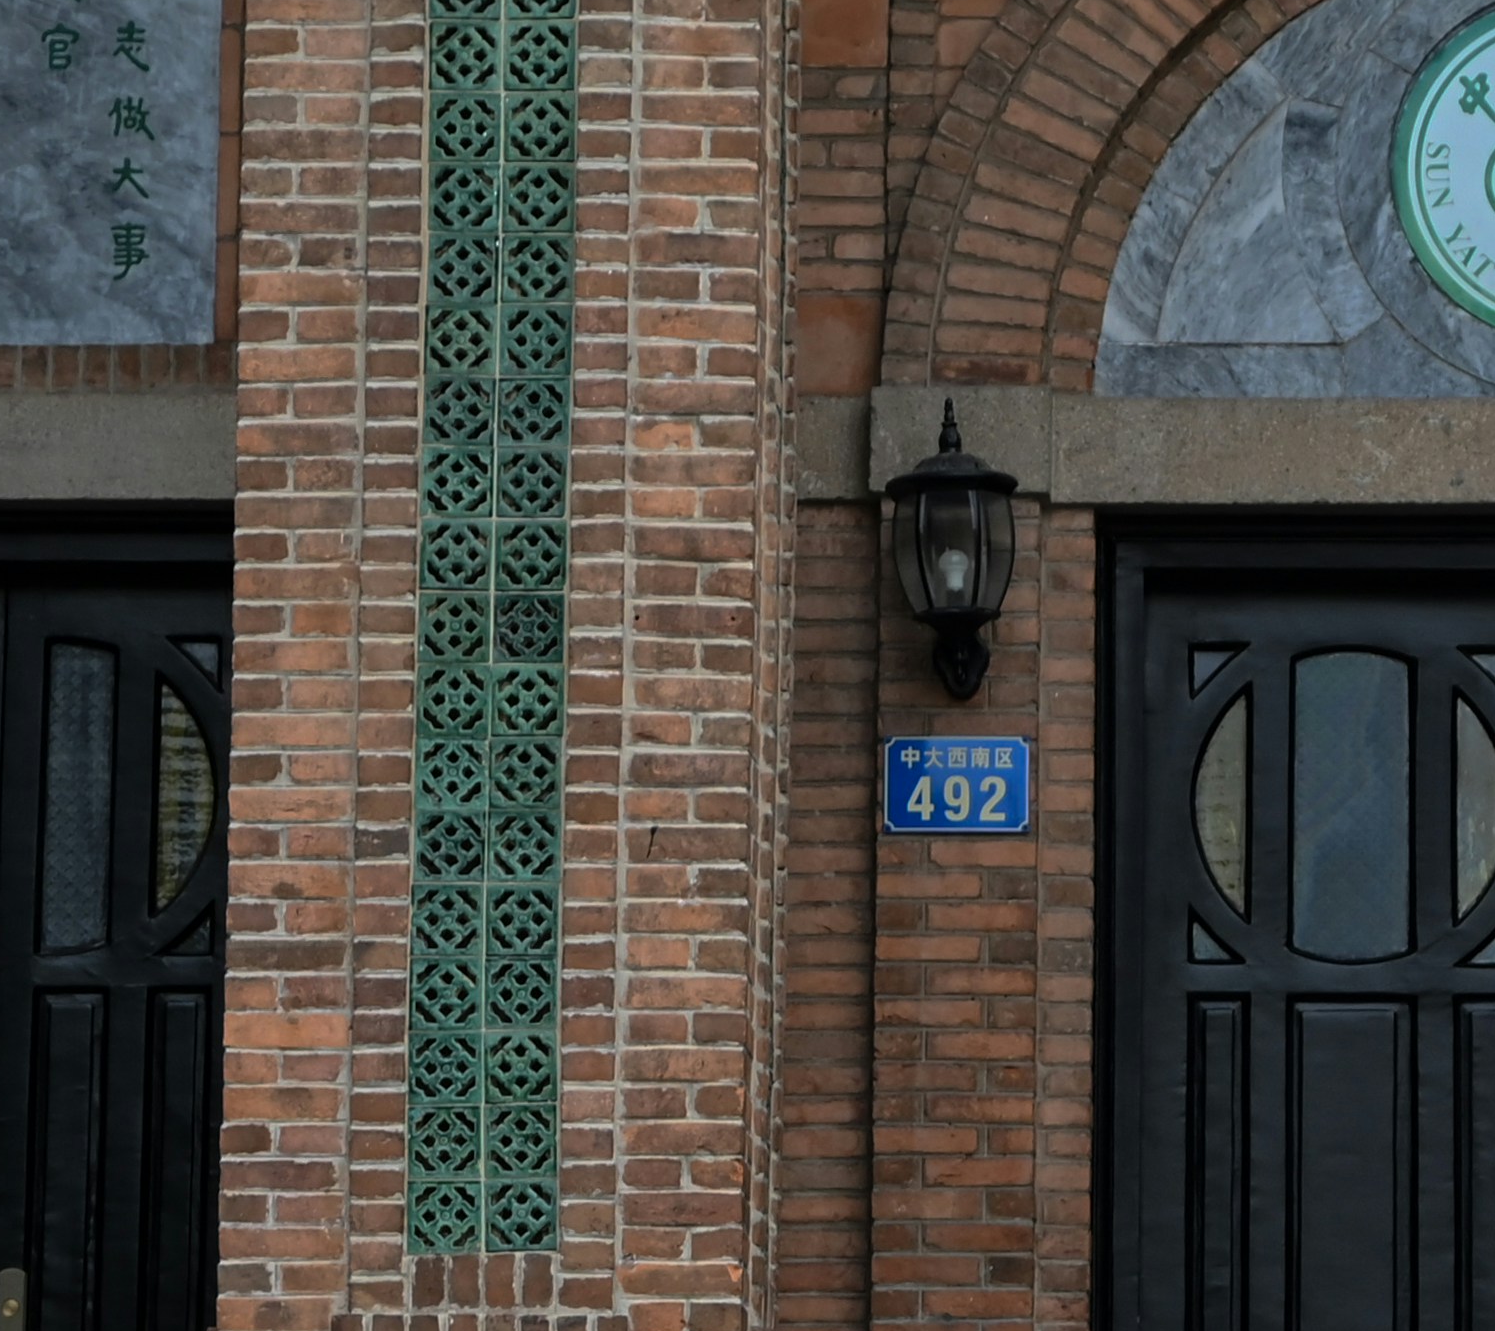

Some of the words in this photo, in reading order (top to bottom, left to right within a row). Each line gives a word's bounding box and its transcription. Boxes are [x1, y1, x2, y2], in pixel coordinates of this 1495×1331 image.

[1424, 141, 1455, 209] SUN
[900, 745, 1014, 770] 中大西南区
[906, 775, 1007, 822] 492
